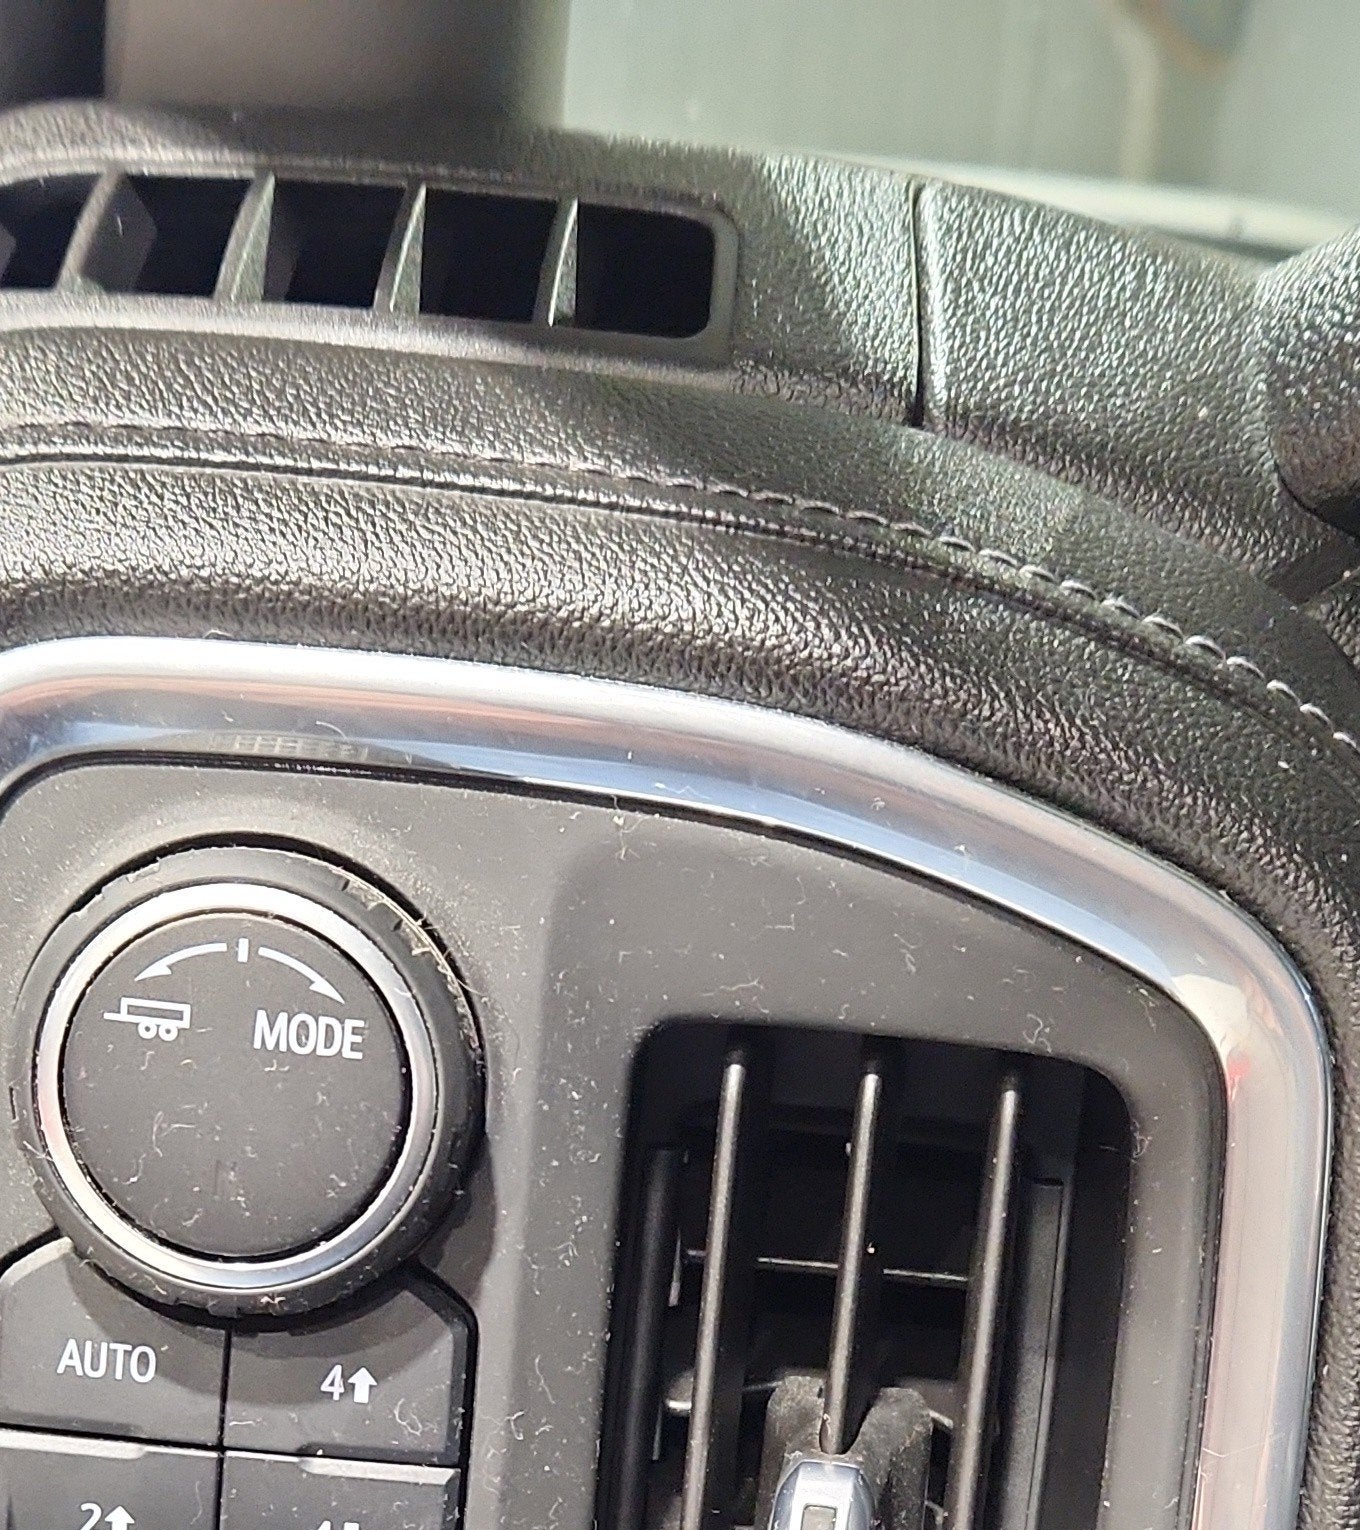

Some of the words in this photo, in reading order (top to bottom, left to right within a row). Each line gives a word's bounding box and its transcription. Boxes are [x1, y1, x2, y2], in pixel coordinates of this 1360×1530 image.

[253, 1009, 364, 1060] MODE
[56, 1339, 157, 1384] AUTO
[320, 1364, 344, 1401] 4
